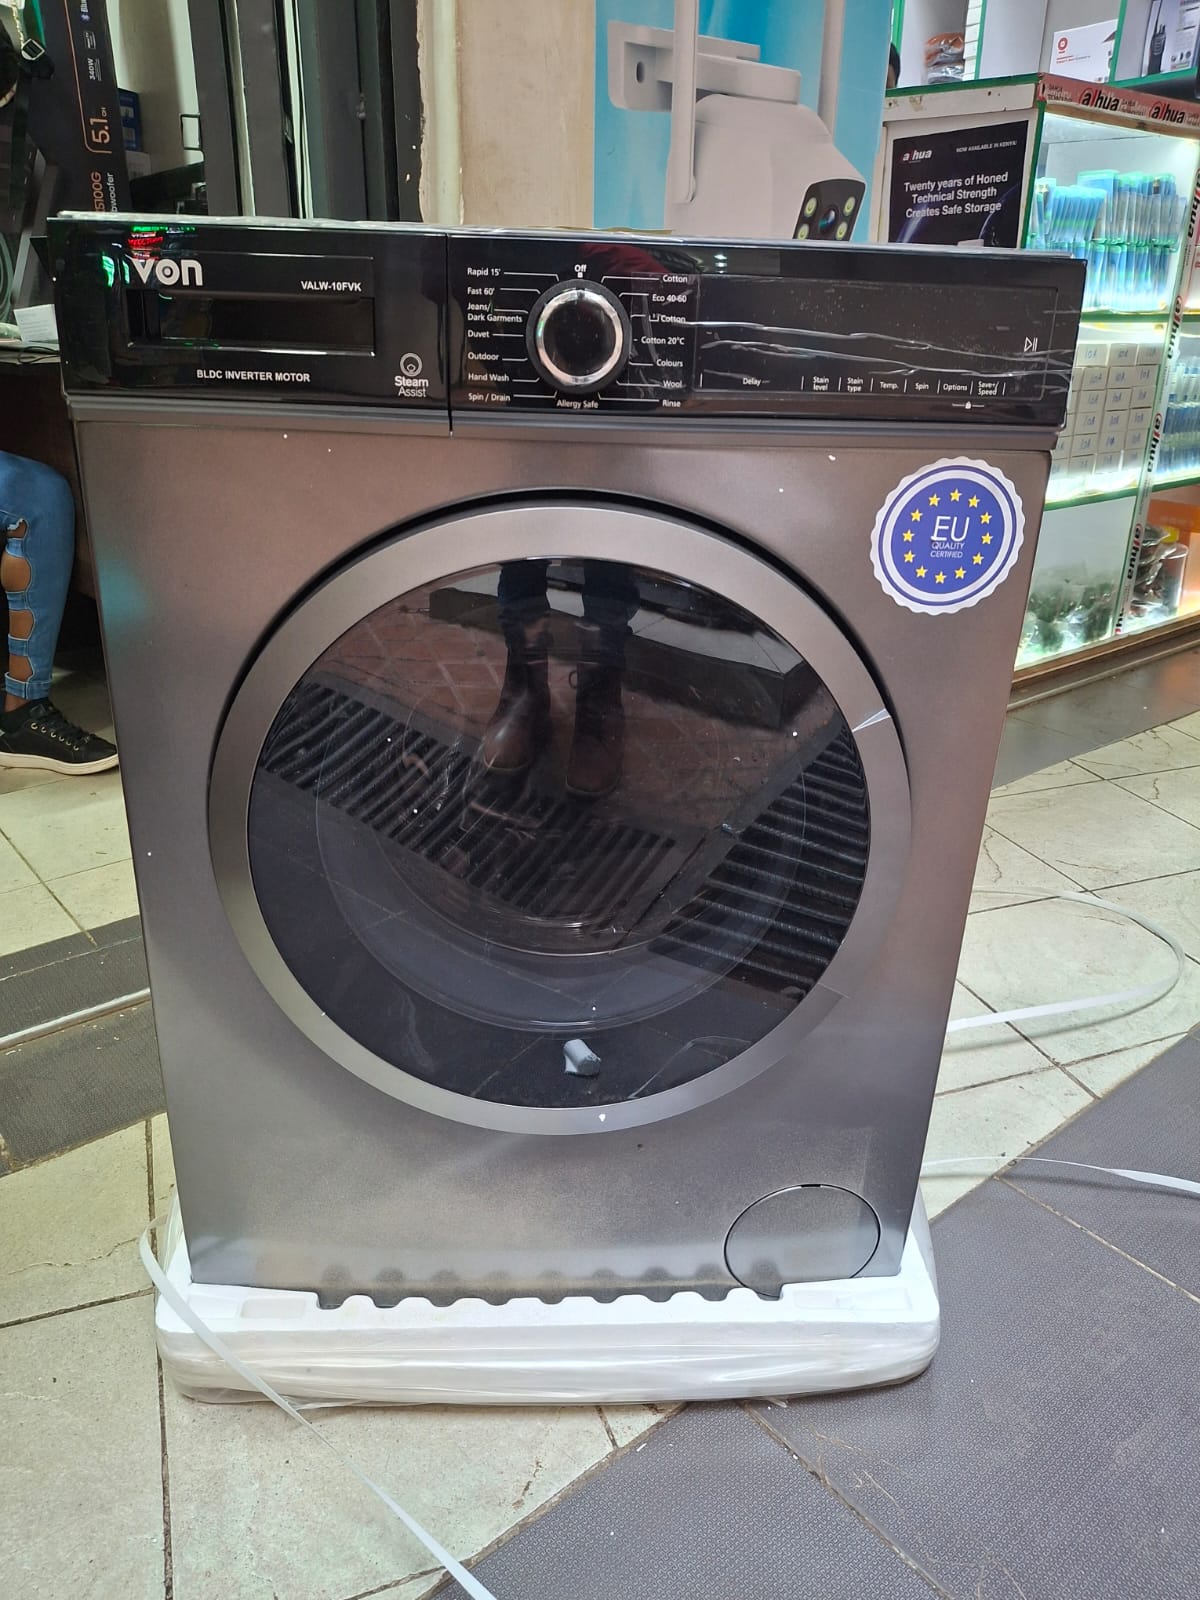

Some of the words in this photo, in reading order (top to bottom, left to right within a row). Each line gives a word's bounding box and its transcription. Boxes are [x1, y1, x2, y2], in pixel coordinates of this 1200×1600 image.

[89, 118, 110, 144] 5.1
[904, 181, 936, 193] Twenty
[937, 178, 963, 191] years
[964, 175, 975, 187] of
[976, 171, 1009, 185] Honed
[912, 191, 955, 204] Technical
[956, 186, 997, 200] Strength
[905, 207, 940, 218] Creates
[941, 204, 963, 215] Safe
[964, 201, 1002, 214] Storage
[131, 258, 203, 286] von
[467, 267, 489, 277] Rapid
[574, 264, 587, 273] Off
[662, 274, 688, 283] Cotton
[300, 280, 362, 292] VALW-10FVK
[467, 287, 482, 296] Fast
[652, 293, 666, 302] Eco
[666, 294, 687, 303] 40-60
[467, 302, 491, 313] Jeans/
[467, 313, 485, 322] Dark
[486, 313, 523, 323] Garments
[660, 314, 687, 323] Cotton
[467, 329, 490, 338] Duvet
[641, 336, 667, 345] Cotton
[667, 336, 685, 345] 20°C
[467, 351, 500, 361] Outdoor
[656, 359, 684, 368] Colours
[196, 369, 223, 379] BLDC
[224, 370, 273, 381] INVERTER
[274, 372, 311, 382] MOTOR
[468, 373, 488, 382] Hand
[488, 373, 510, 382] Wash
[813, 376, 830, 384] Stain
[394, 375, 429, 387] Steam
[662, 380, 683, 389] Wool
[742, 377, 761, 387] Delay
[847, 377, 864, 385] Stain
[880, 381, 899, 390] Temp.
[847, 384, 862, 393] type
[915, 382, 930, 391] Spin
[943, 383, 968, 392] Options
[398, 387, 427, 398] Assist
[977, 387, 997, 397] Speed
[468, 393, 484, 402] Spin
[490, 393, 511, 402] Drain
[556, 399, 582, 410] Allergy
[583, 400, 599, 409] Safe
[662, 399, 681, 408] Rinse
[930, 515, 970, 542] EU
[931, 542, 966, 550] QUALITY
[930, 550, 964, 559] CERTIFIED
